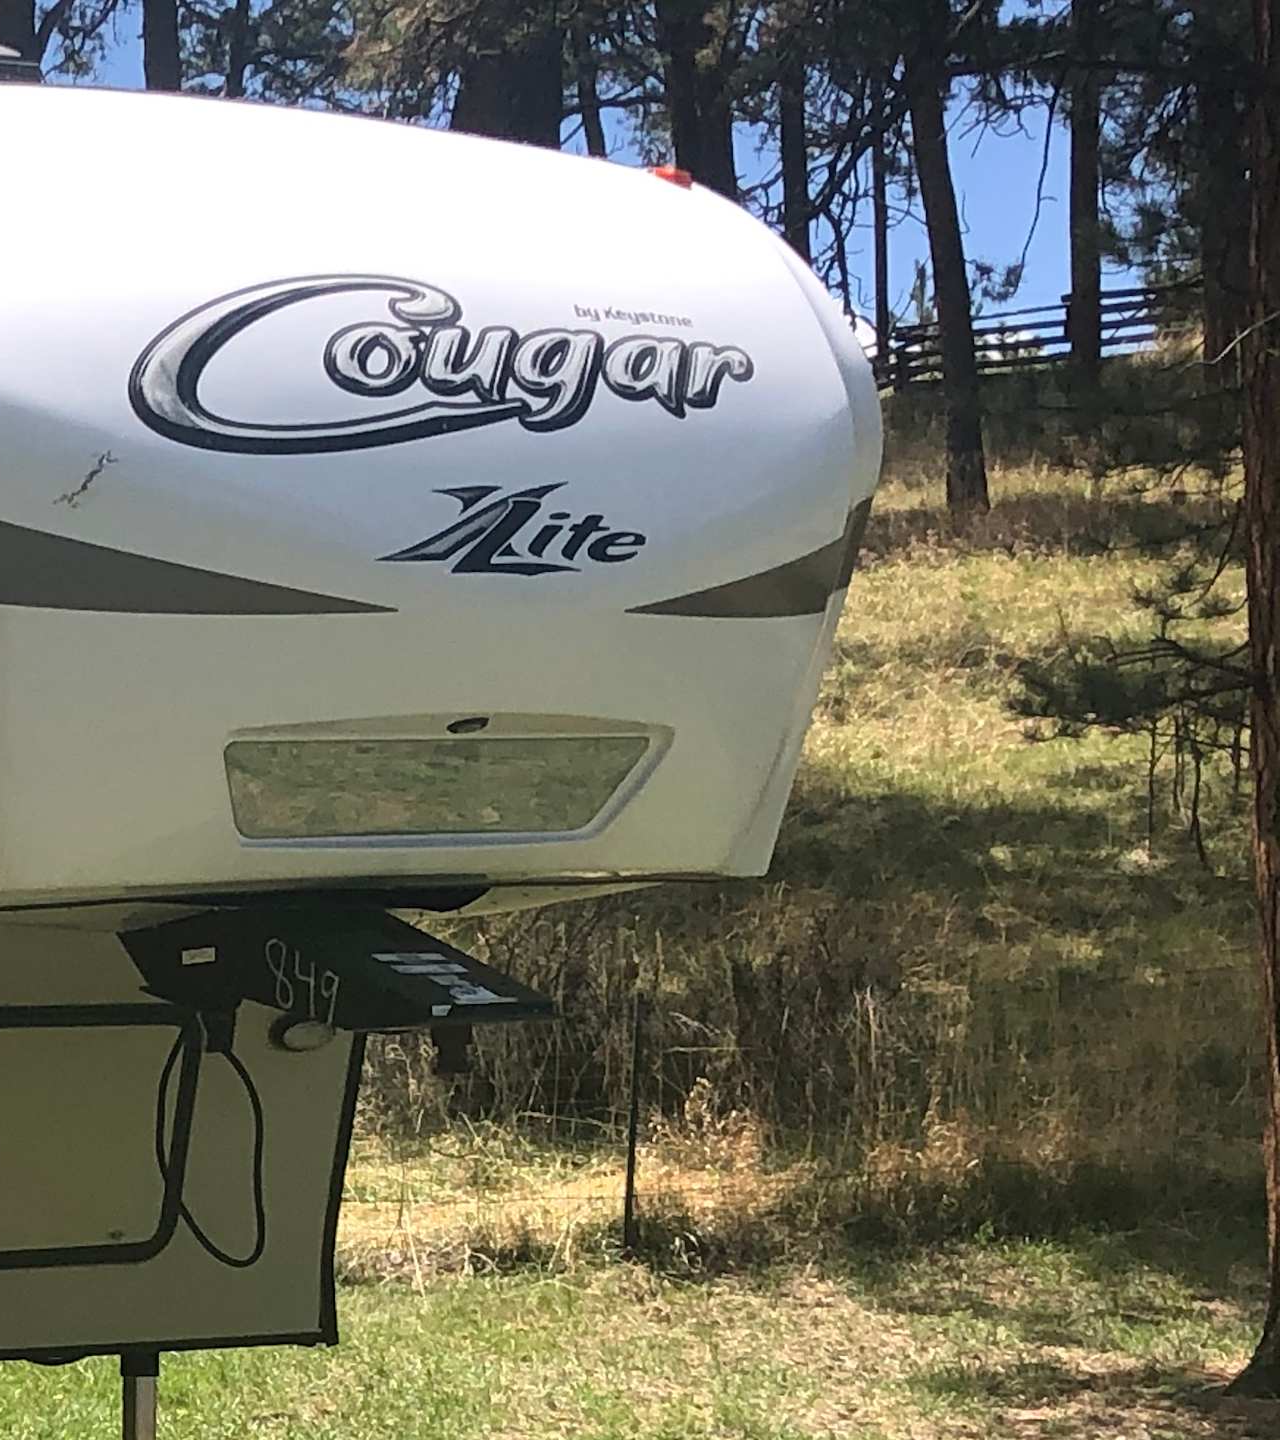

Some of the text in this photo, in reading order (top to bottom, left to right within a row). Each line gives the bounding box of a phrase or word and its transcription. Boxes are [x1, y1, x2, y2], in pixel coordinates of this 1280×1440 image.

[573, 303, 601, 322] by
[129, 274, 753, 454] Cougar
[265, 938, 339, 1025] 849
